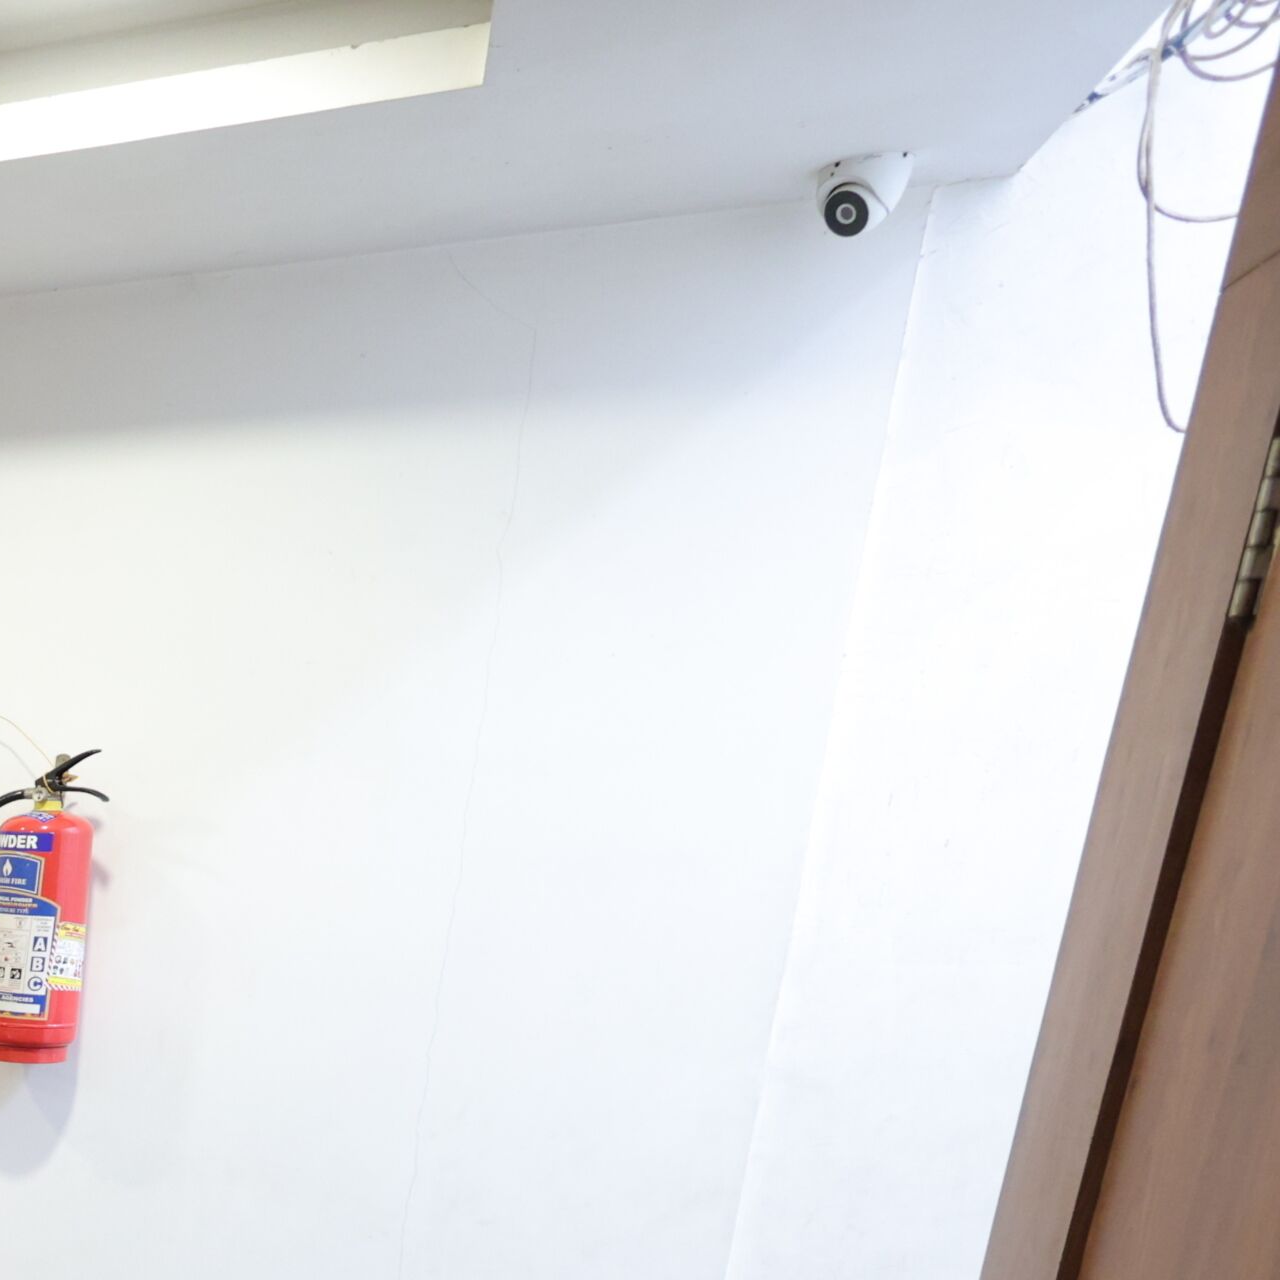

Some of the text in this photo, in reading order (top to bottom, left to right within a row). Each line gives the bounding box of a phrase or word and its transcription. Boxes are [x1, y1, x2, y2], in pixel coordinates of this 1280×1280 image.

[33, 937, 47, 952] A
[31, 957, 45, 972] B
[28, 976, 43, 991] C
